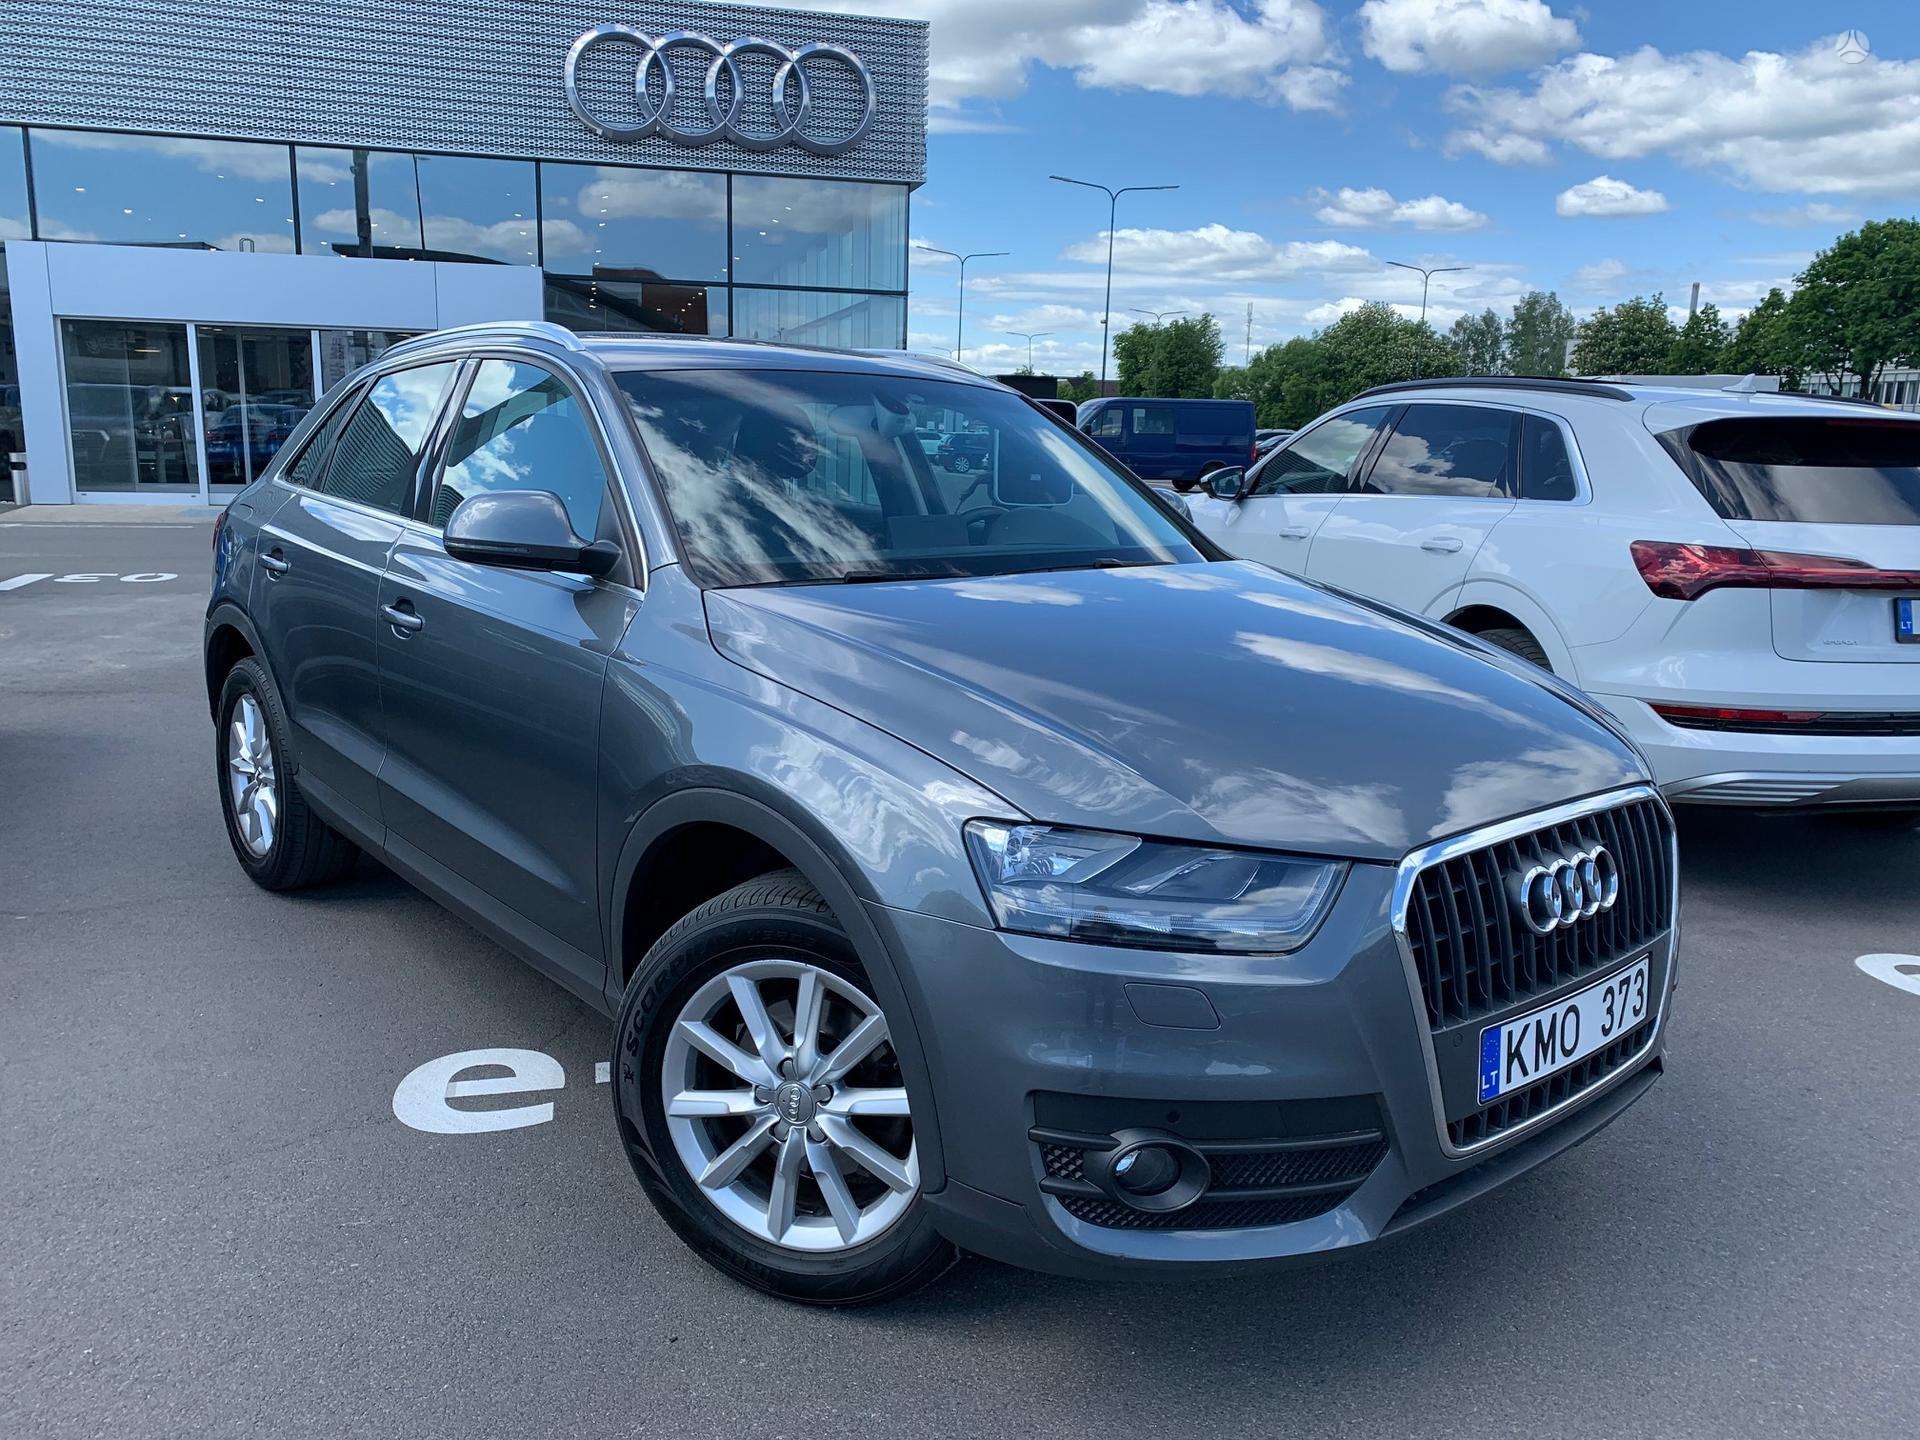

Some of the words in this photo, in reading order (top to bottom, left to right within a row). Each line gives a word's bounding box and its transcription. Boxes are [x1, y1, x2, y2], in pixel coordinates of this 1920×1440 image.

[1901, 621, 1912, 630] LT
[1505, 1004, 1580, 1085] KMO
[1601, 967, 1646, 1037] 373
[1481, 1070, 1499, 1090] LT
